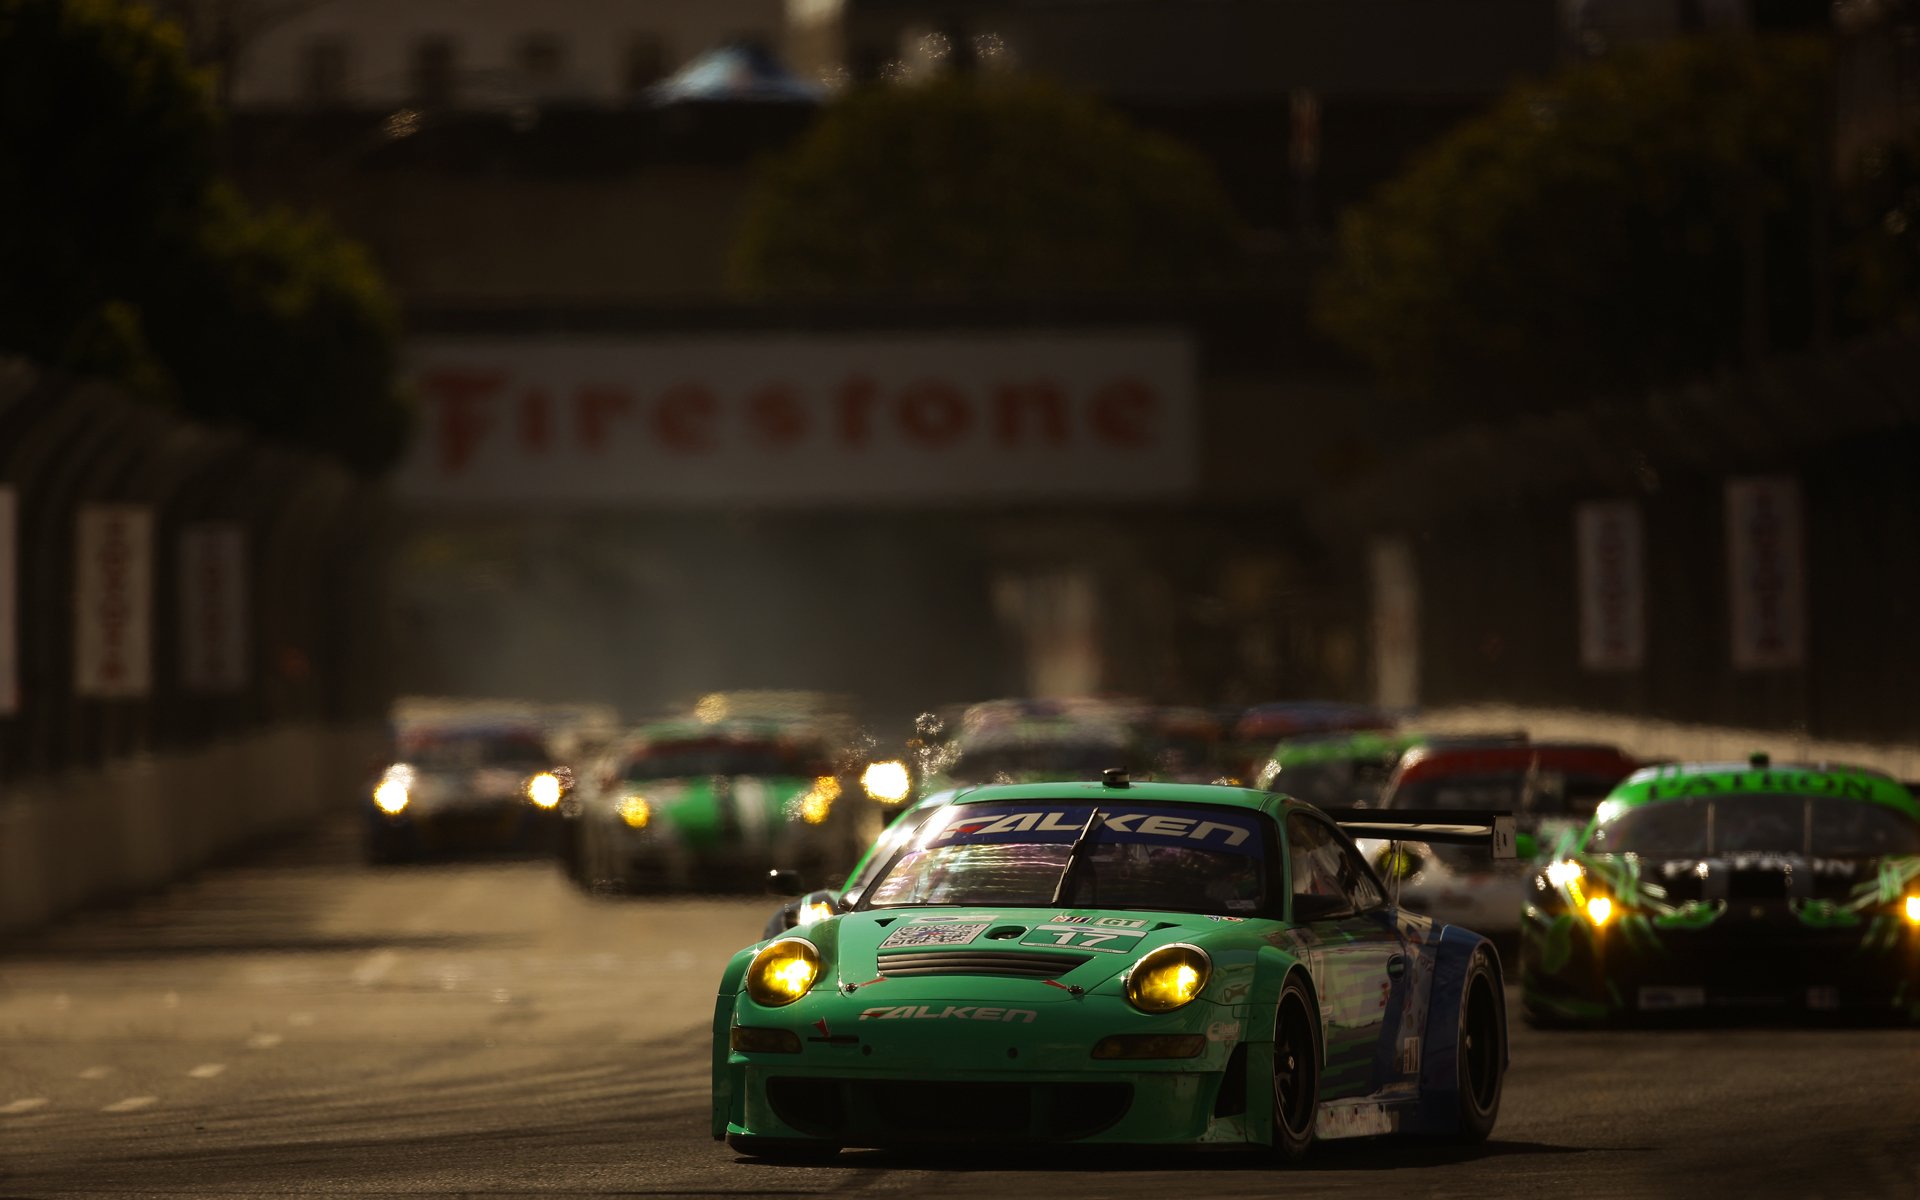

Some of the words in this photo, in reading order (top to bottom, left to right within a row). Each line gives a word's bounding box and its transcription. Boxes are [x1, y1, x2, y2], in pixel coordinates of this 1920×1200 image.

[420, 368, 1162, 474] Firestone
[938, 811, 1251, 847] FALKEN
[1101, 917, 1142, 928] GT
[1052, 931, 1119, 947] 17
[858, 1005, 1038, 1023] FALKEN
